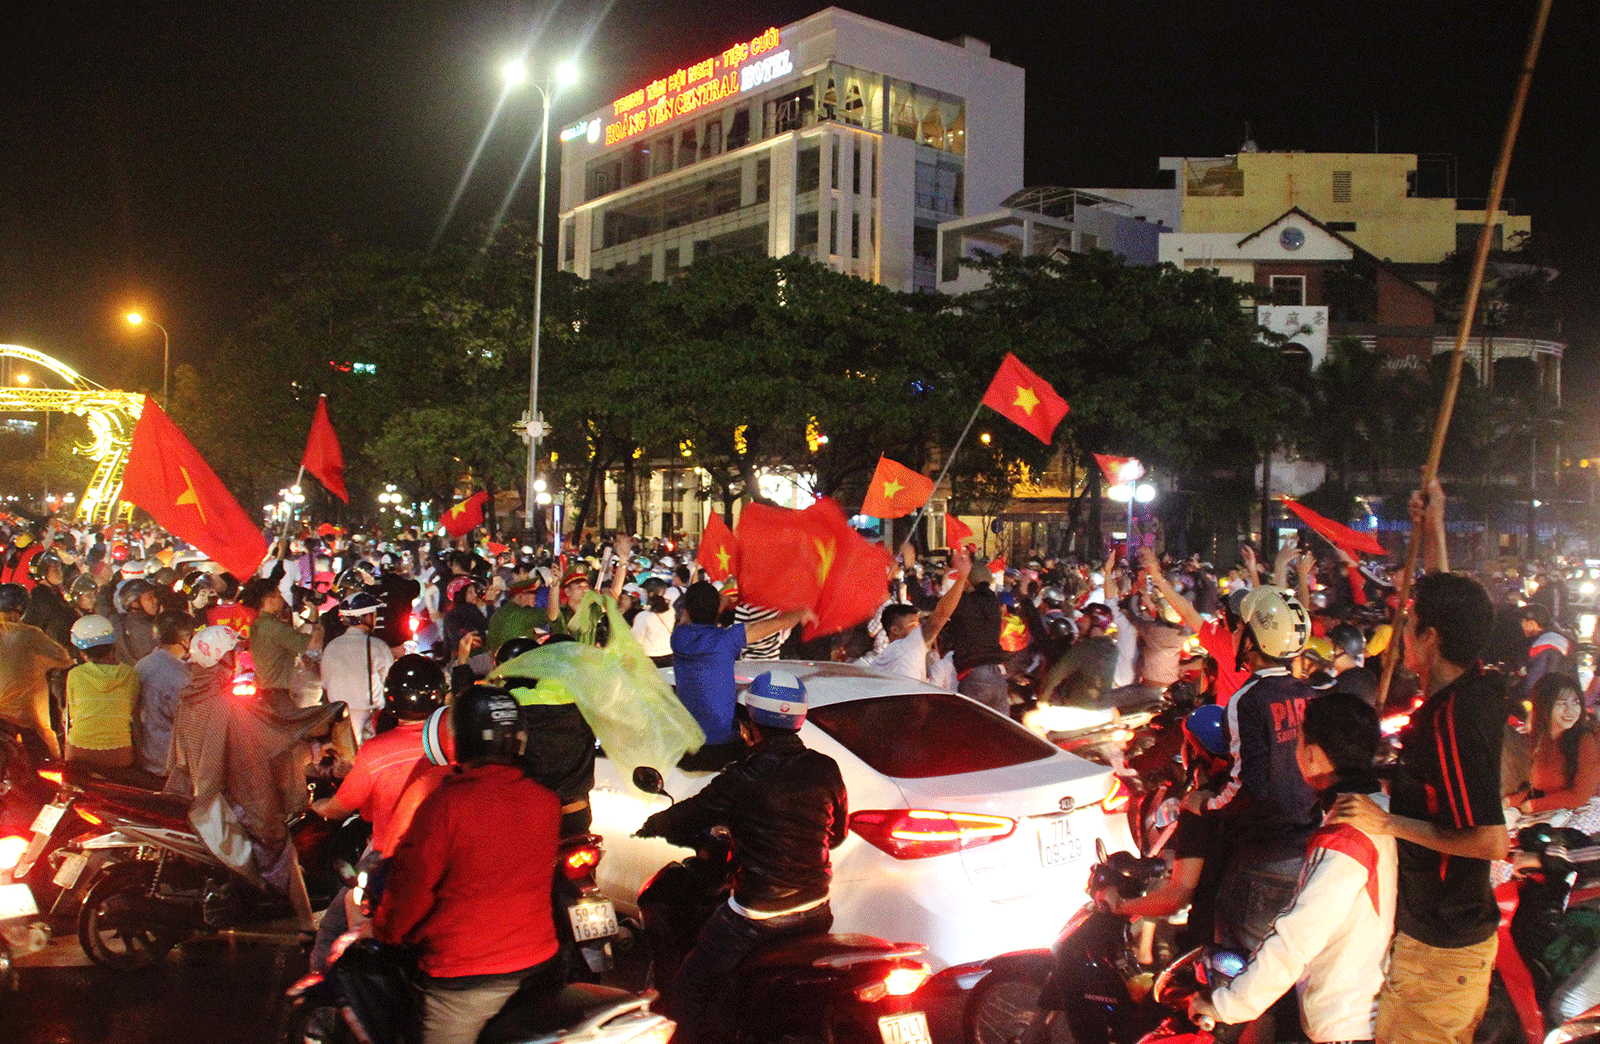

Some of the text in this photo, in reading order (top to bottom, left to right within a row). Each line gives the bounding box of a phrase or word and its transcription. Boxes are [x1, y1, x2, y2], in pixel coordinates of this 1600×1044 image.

[722, 42, 749, 68] TIỆC
[750, 26, 780, 56] CƯỚI
[674, 71, 740, 115] CENTRAL
[740, 49, 793, 92] HOTEL
[1051, 818, 1072, 841] 77A
